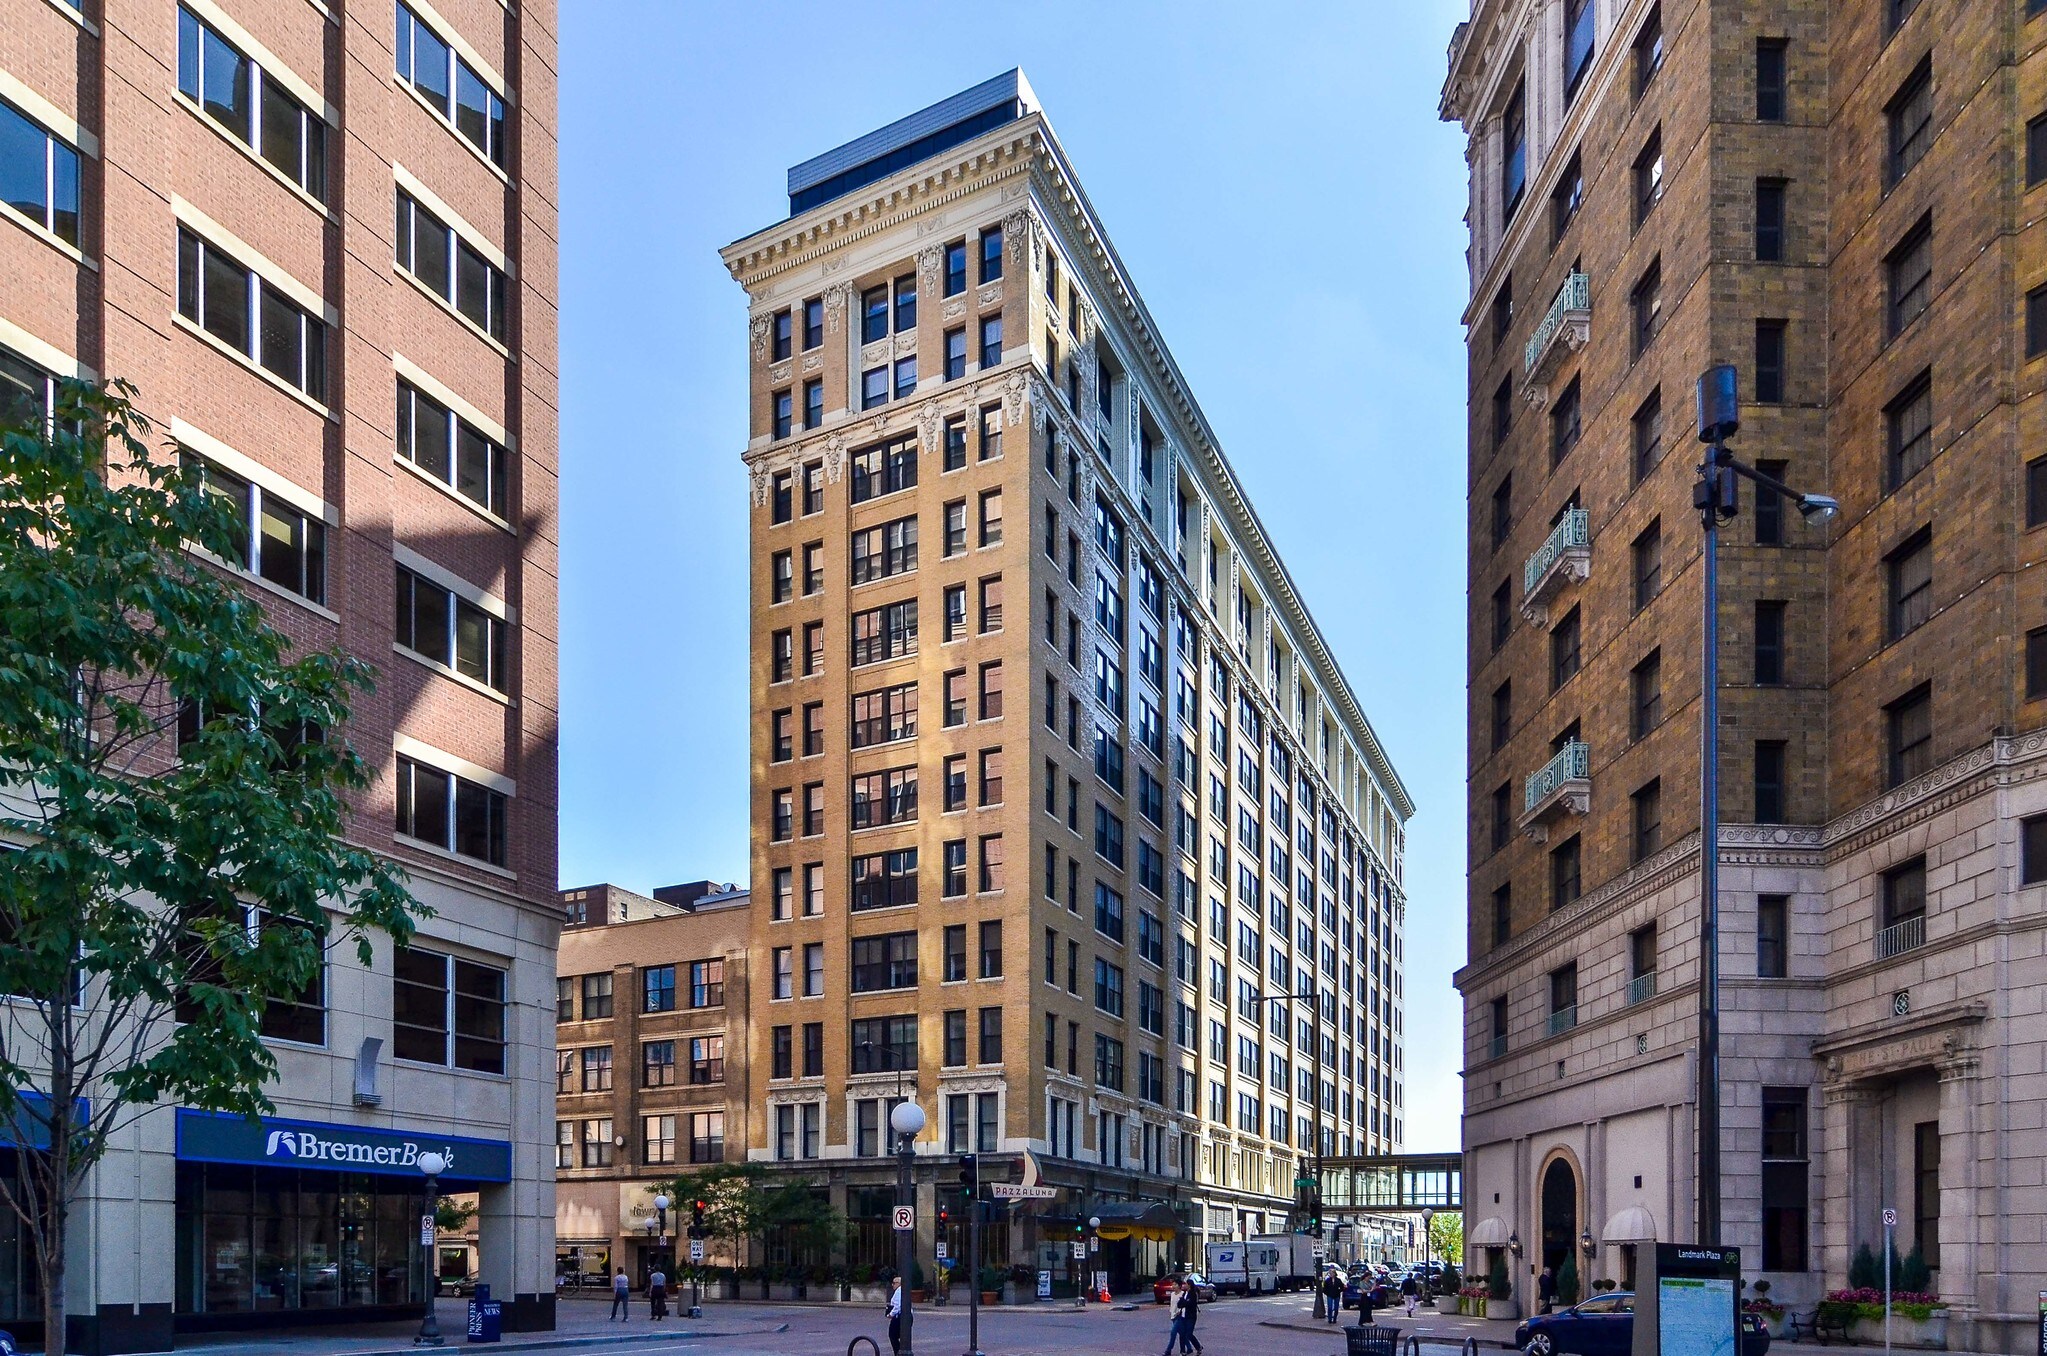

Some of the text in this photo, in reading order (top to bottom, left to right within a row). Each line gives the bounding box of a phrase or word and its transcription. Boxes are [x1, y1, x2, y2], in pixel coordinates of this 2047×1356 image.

[1901, 1035, 1936, 1057] PAUL
[298, 1133, 454, 1169] BremerBk
[995, 1186, 1053, 1196] PAZZALUNA
[1678, 1249, 1721, 1259] Landmark Plaza
[468, 1302, 476, 1335] PIONEER
